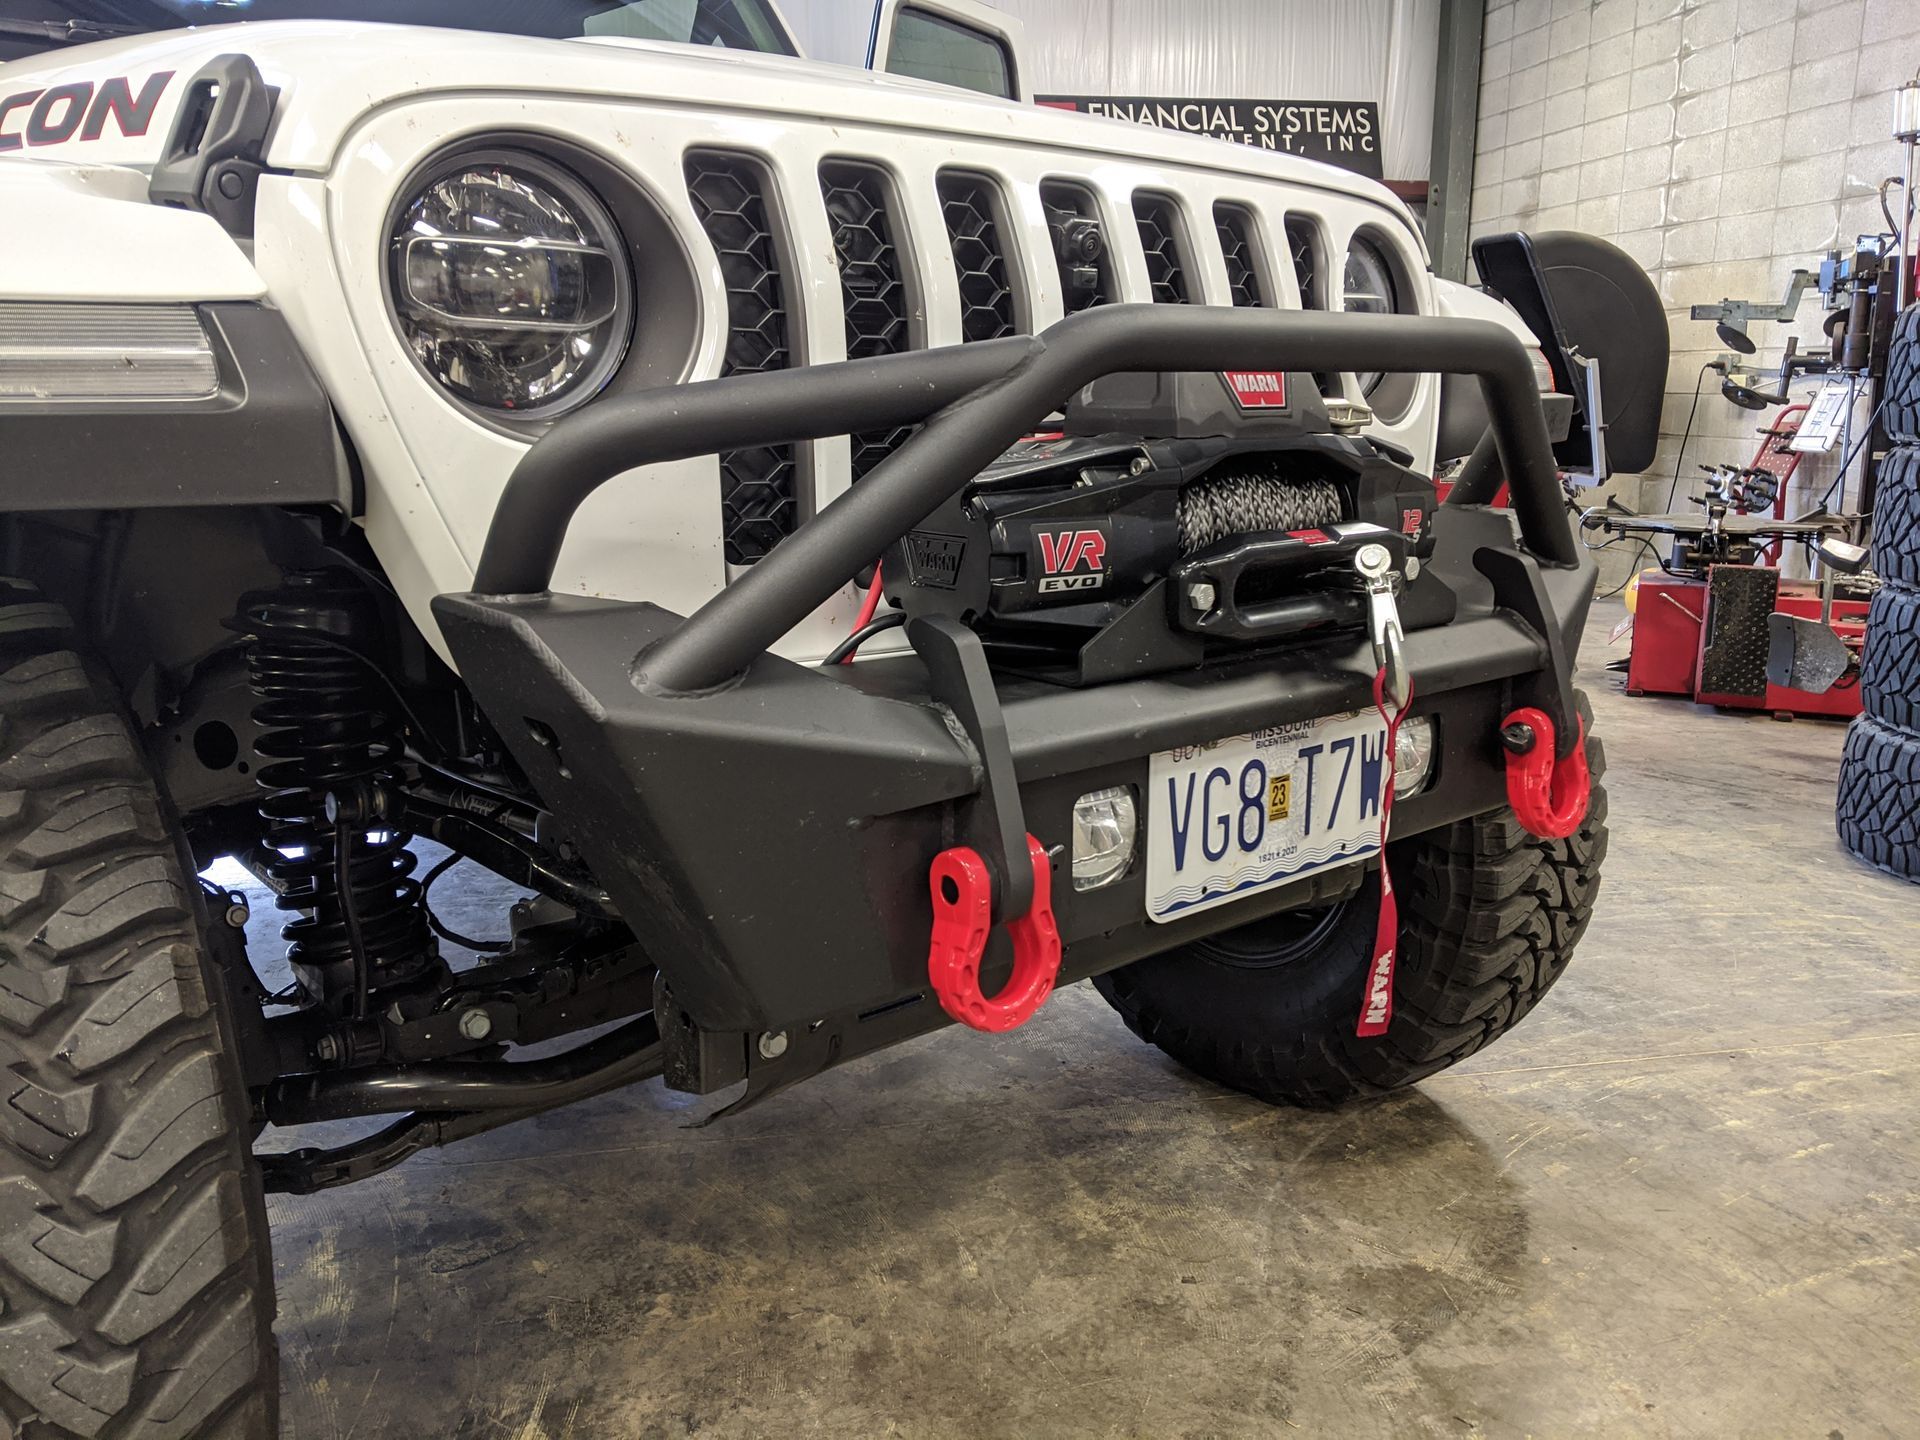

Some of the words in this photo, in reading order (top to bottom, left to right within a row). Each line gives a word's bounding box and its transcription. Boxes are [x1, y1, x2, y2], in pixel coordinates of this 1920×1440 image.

[0, 70, 176, 152] CON
[1088, 102, 1244, 131] FINANCIAL
[1254, 105, 1371, 135] SYSTEMS
[1327, 135, 1375, 152] INC
[1233, 374, 1280, 392] WARN
[1402, 509, 1422, 534] 12
[1037, 529, 1107, 574] VR
[1044, 576, 1097, 591] EVO
[1250, 719, 1315, 741] MISSOURI
[1256, 731, 1310, 750] BICENTENNIAL
[1168, 758, 1267, 873] VG8
[1298, 730, 1386, 836] T7W
[1271, 783, 1286, 807] 23
[1282, 846, 1298, 859] 2021
[1365, 949, 1394, 1024] WARN
